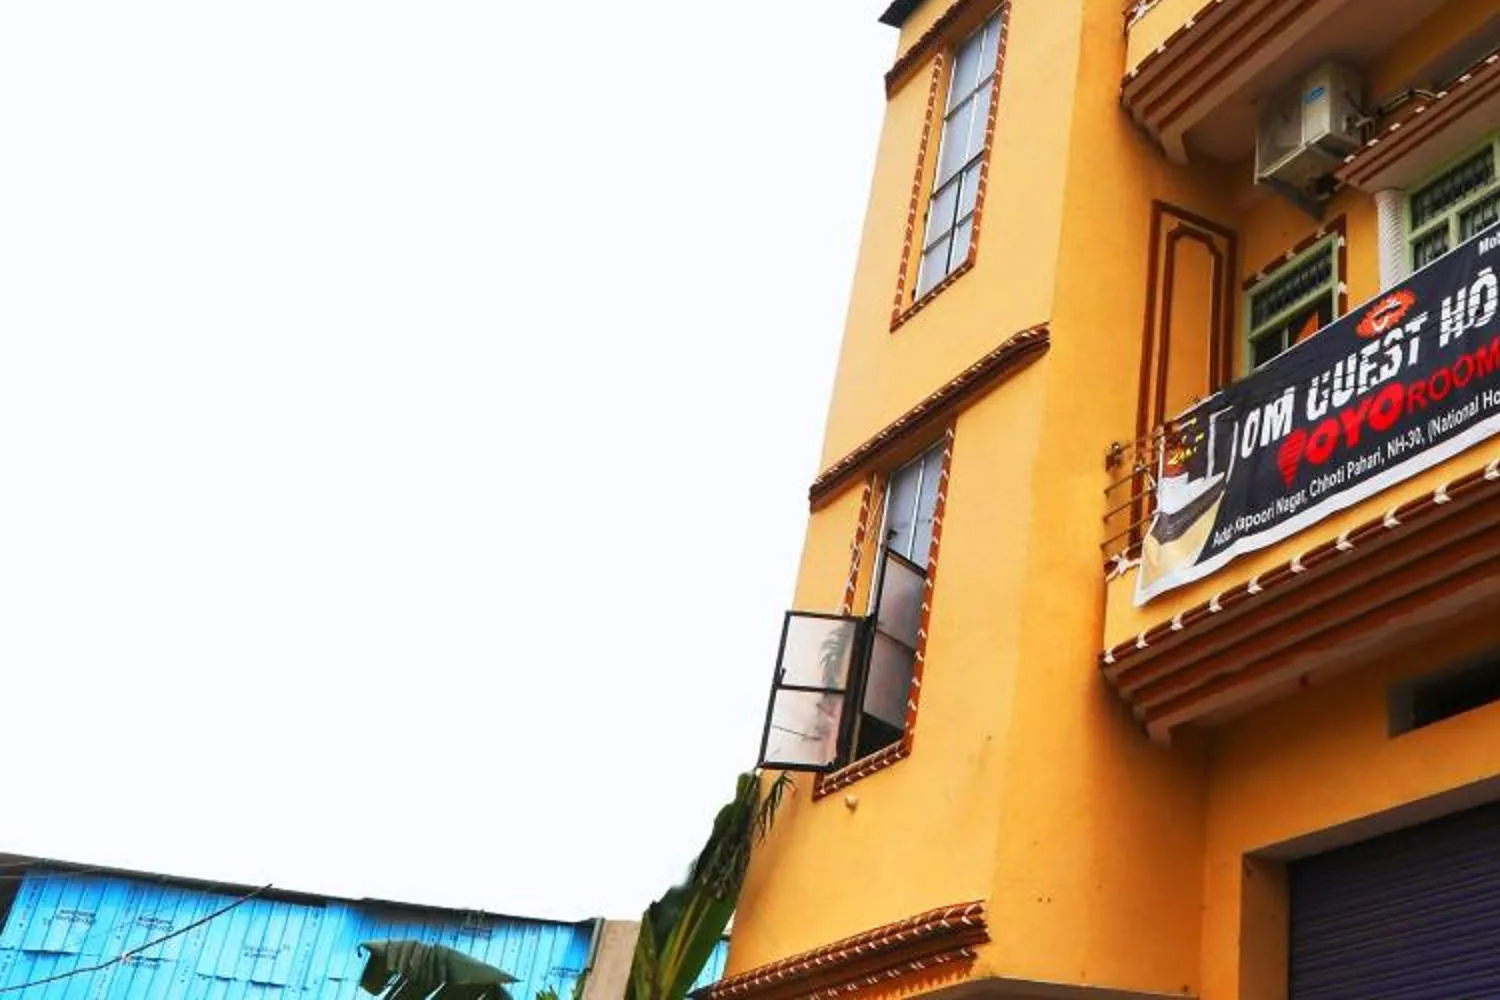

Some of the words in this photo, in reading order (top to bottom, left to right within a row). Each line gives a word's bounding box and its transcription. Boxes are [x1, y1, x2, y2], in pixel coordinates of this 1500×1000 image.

[1241, 385, 1296, 459] OM
[1307, 311, 1429, 422] GUEST
[1309, 465, 1345, 498] Chhoti
